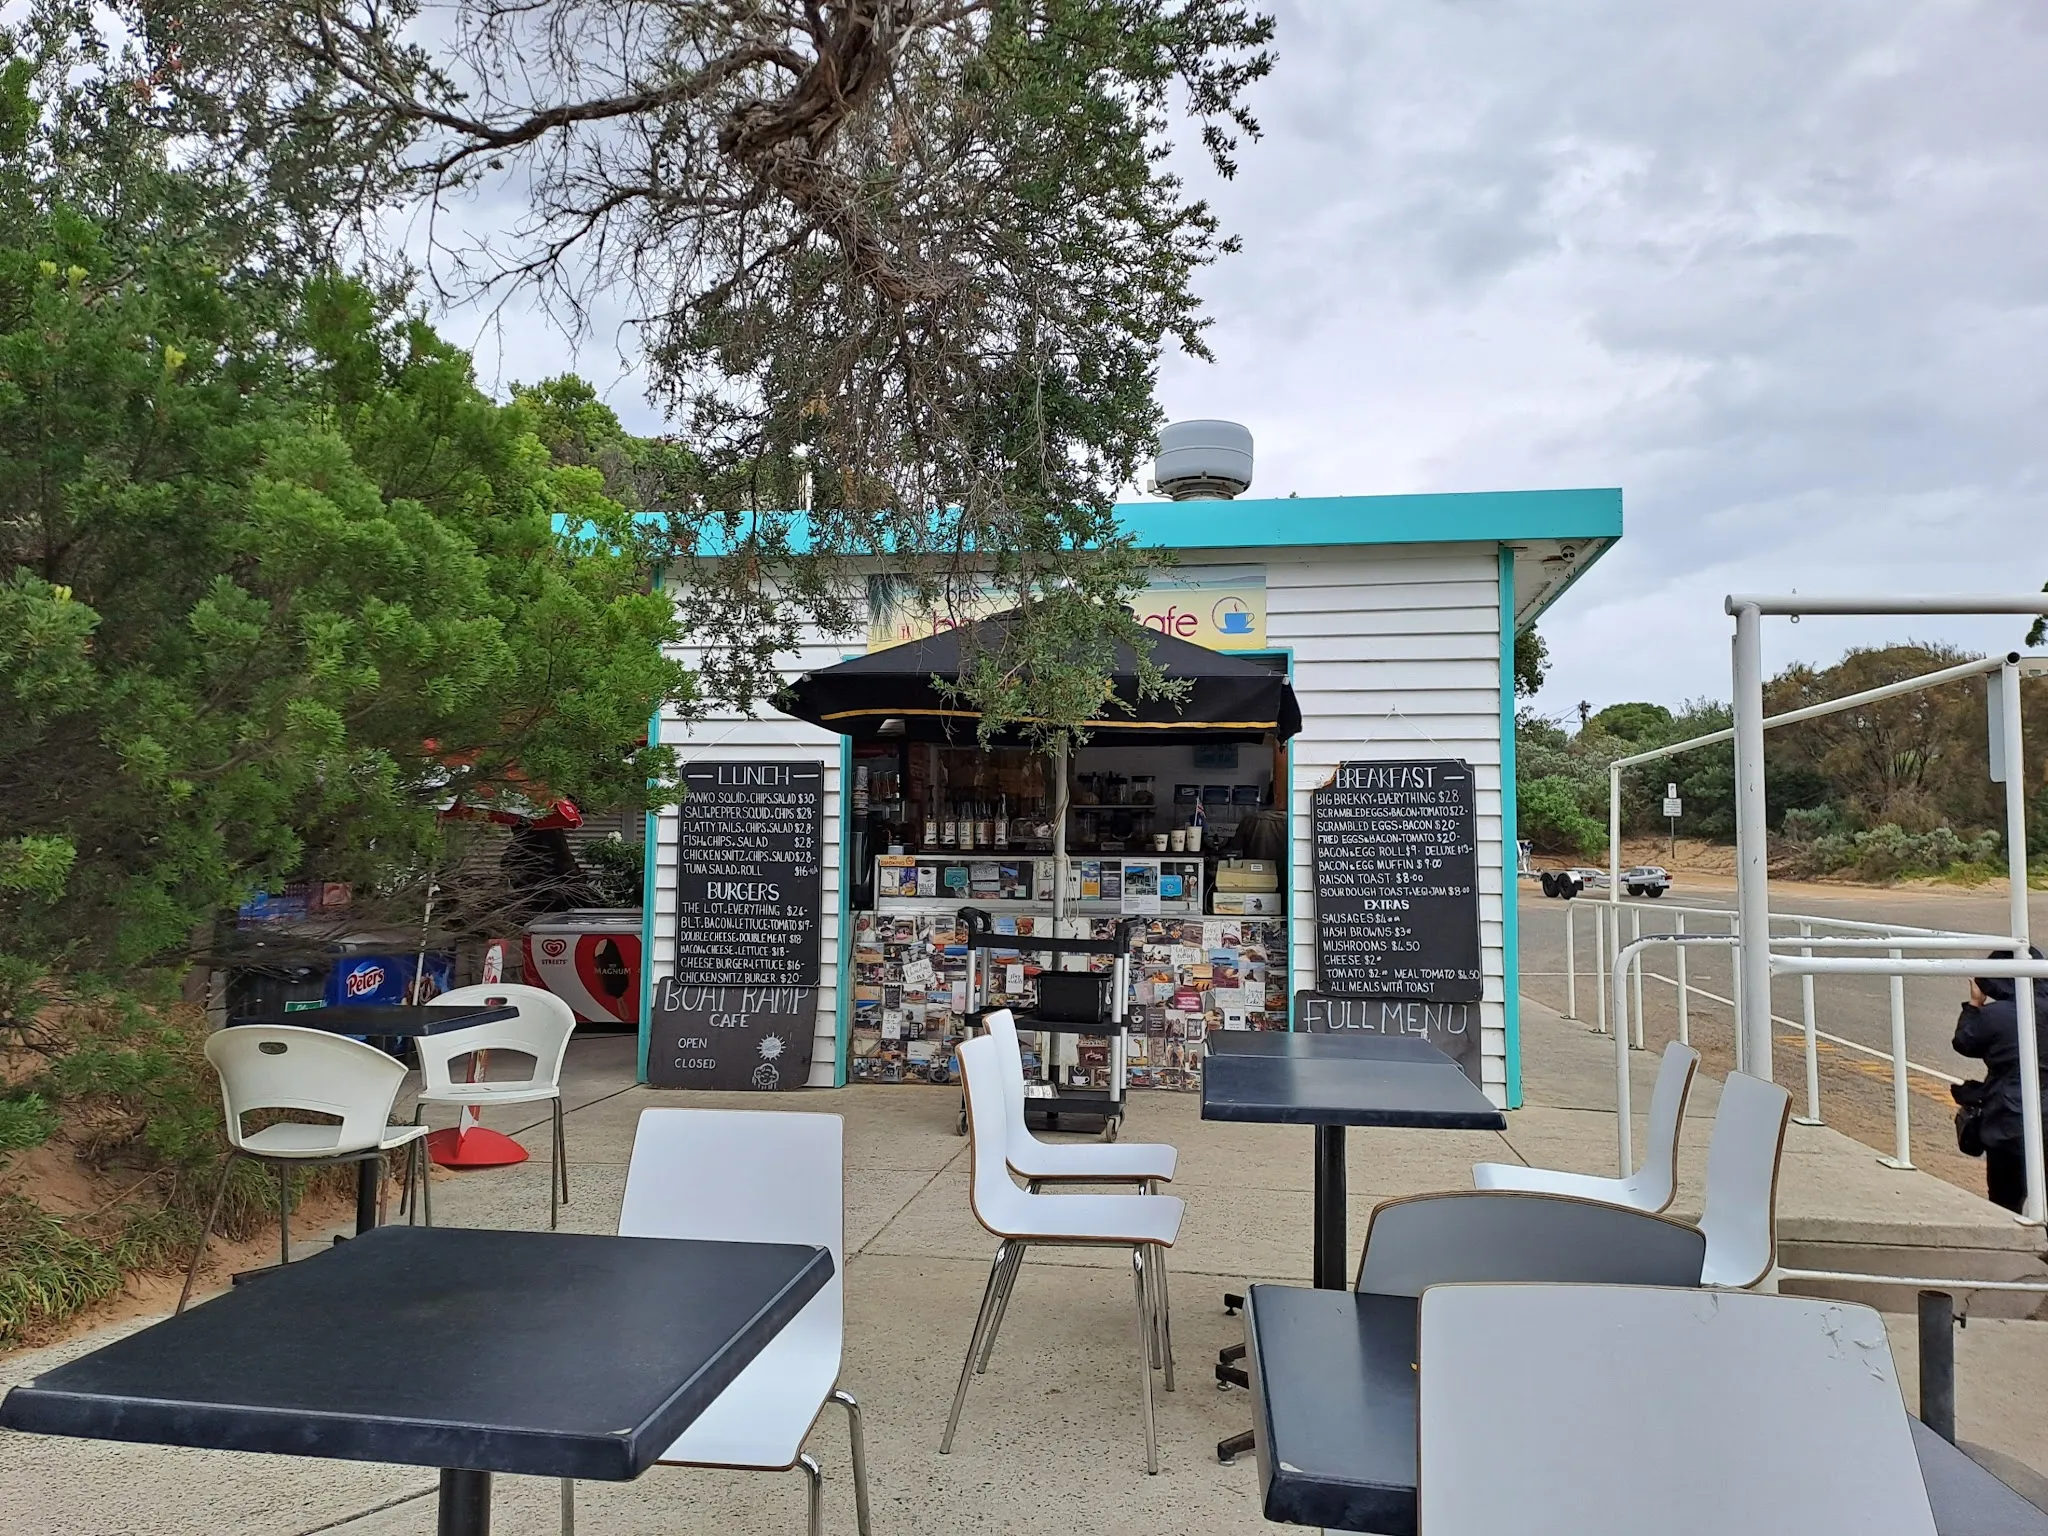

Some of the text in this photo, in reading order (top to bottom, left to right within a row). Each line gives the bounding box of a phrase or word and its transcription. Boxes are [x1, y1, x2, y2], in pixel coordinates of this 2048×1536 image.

[1138, 606, 1199, 637] afe
[718, 766, 789, 785] LUNCH
[1336, 766, 1437, 789] BREAKFAST
[684, 792, 716, 803] PANKO
[1316, 793, 1332, 805] BIG
[1317, 821, 1369, 832] SCRAMBLED
[1403, 820, 1432, 831] BACON
[737, 836, 768, 848] SALAD
[1318, 834, 1339, 844] FRIED
[1401, 833, 1435, 843] TOMATO
[683, 849, 721, 861] CHICKEN
[1380, 846, 1405, 857] ROLL
[1425, 845, 1458, 856] DELUXE
[684, 863, 708, 875] TUNA
[741, 864, 763, 876] ROLL
[1377, 859, 1414, 870] MUFFIN
[1319, 874, 1354, 885] RAISON
[707, 881, 780, 901] BURGERS
[682, 902, 700, 914] THE
[728, 903, 780, 916] EVERYTHING
[1364, 899, 1410, 910] EXTRAS
[1322, 913, 1373, 924] SAUSAGES
[1322, 926, 1346, 937] HASH
[1322, 940, 1387, 952] MUSHROOMS
[1324, 954, 1361, 965] CHEESE
[594, 967, 632, 975] MAGNUM
[680, 971, 718, 983] CHICKEN
[1326, 969, 1365, 979] TOMATO
[1420, 968, 1455, 980] TOMATO
[1331, 982, 1347, 992] ALL
[1349, 981, 1379, 993] MEALS
[1405, 982, 1435, 993] TOAST
[709, 1013, 750, 1027] CAFE
[1303, 1000, 1468, 1034] FULL MENU
[678, 1037, 707, 1049] OPEN
[674, 1057, 716, 1070] CLOSED
